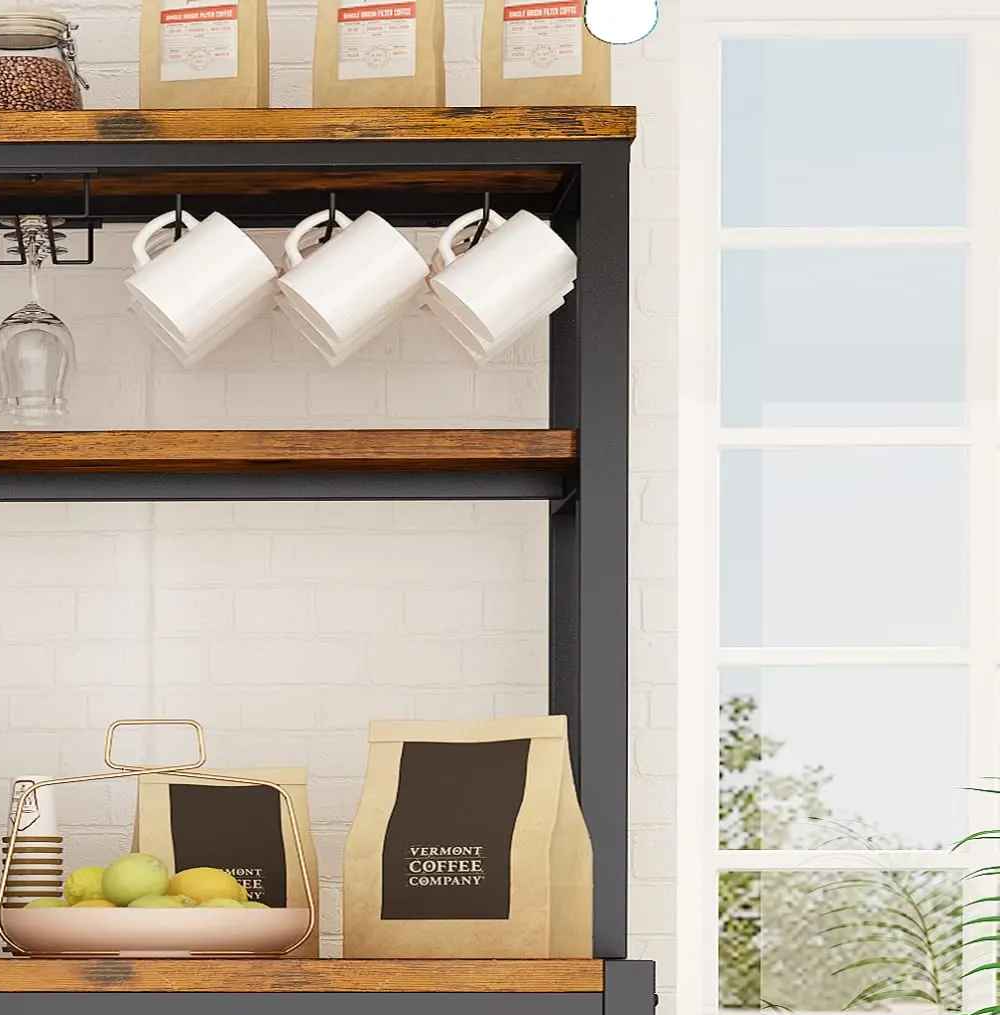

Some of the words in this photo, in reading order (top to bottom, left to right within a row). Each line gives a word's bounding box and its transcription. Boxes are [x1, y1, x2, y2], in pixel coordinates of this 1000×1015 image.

[215, 9, 232, 17] COFFEE
[377, 9, 393, 17] FILTER
[393, 7, 411, 16] COFFEE
[543, 7, 559, 16] FILTER
[559, 6, 577, 15] COFFEE
[410, 846, 483, 856] VERMONT
[408, 860, 483, 873] COFFEE
[224, 868, 262, 876] MONT
[408, 875, 482, 886] COMPANY
